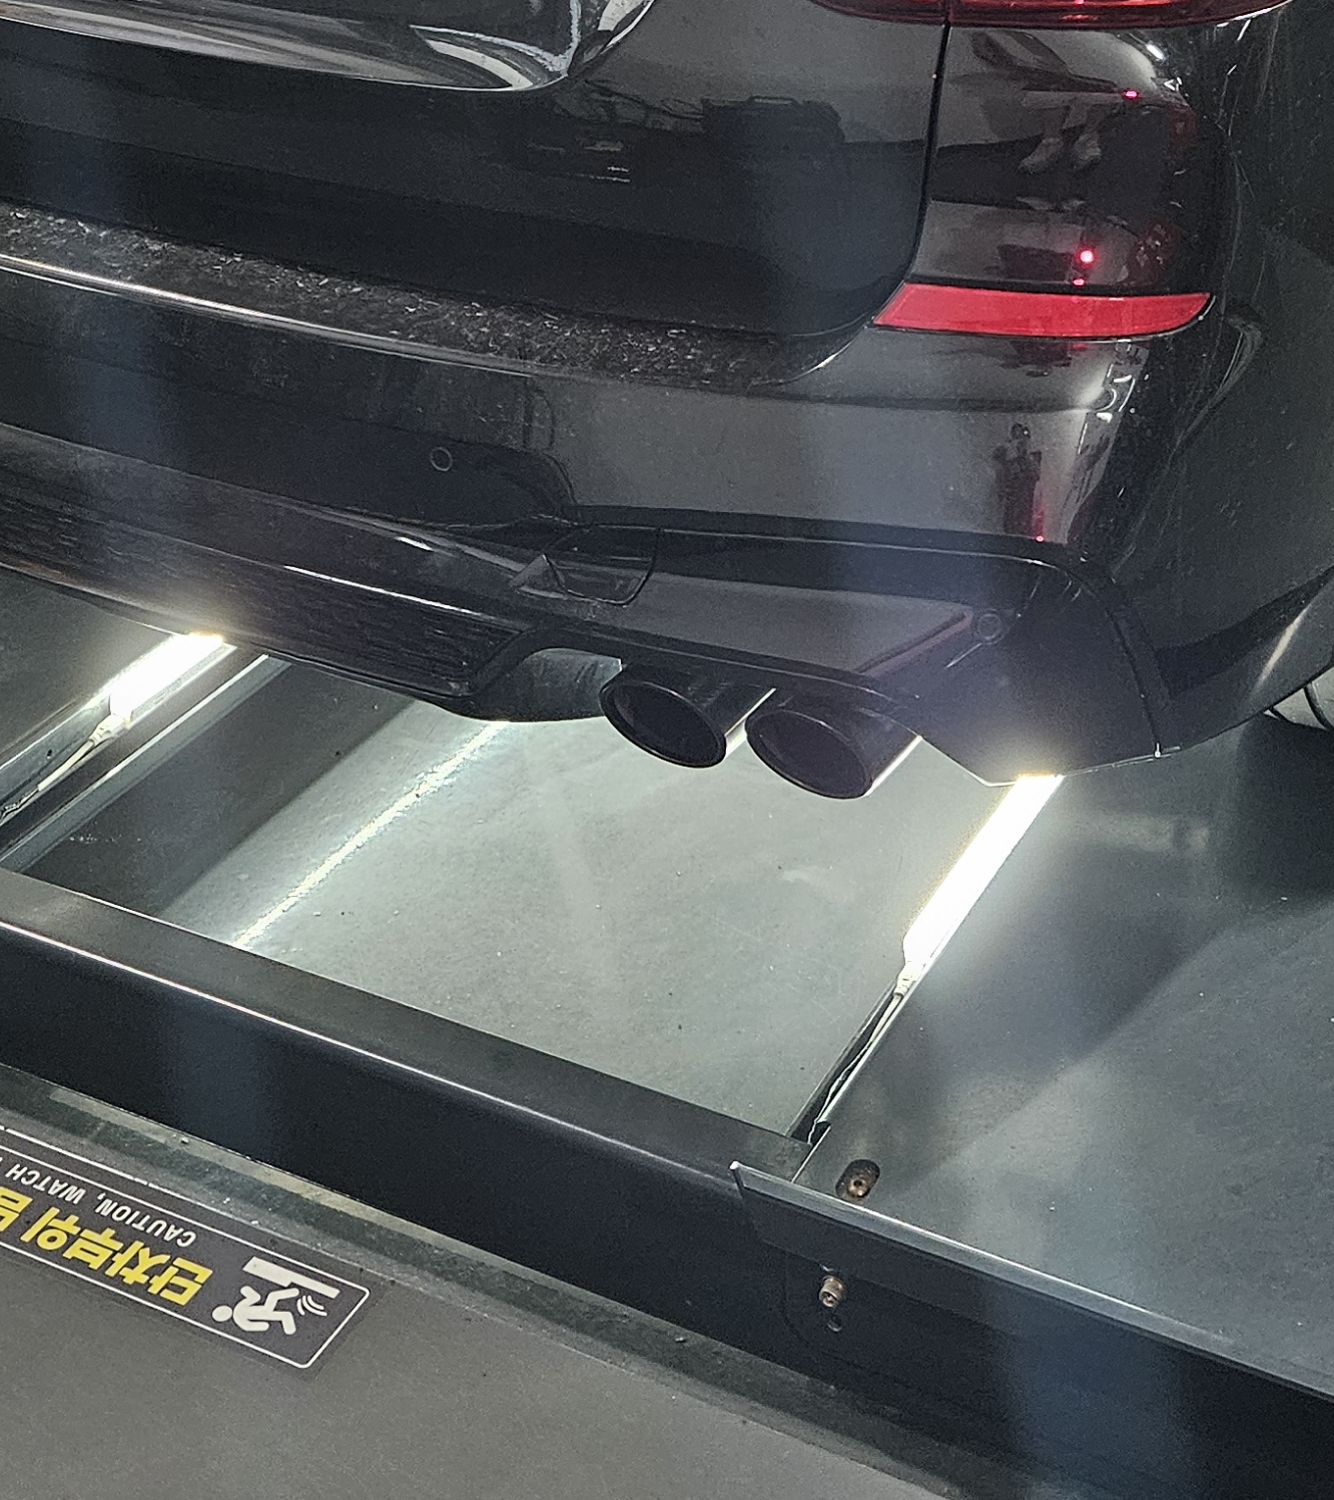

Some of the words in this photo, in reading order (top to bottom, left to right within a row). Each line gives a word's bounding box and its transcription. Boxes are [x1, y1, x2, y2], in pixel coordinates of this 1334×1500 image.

[5, 1163, 86, 1205] WATCH
[95, 1192, 197, 1248] CAUTION,
[20, 1206, 213, 1306] 단차부위
